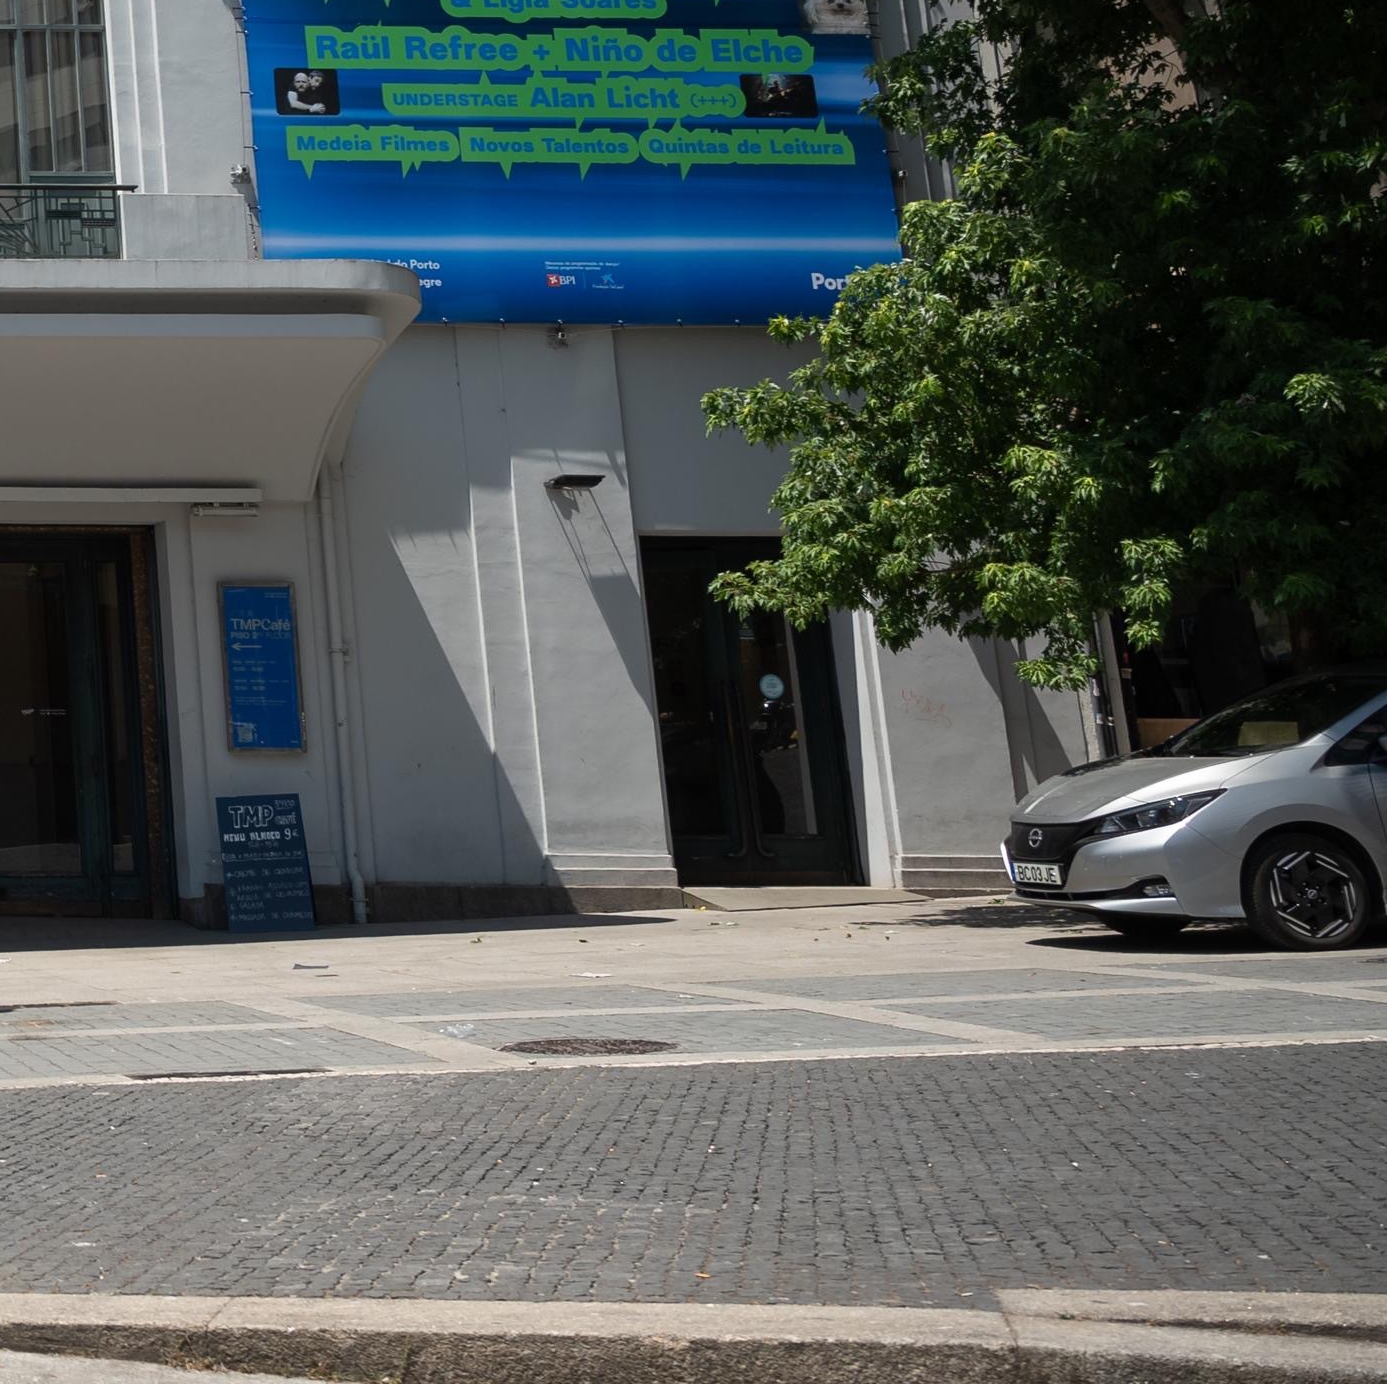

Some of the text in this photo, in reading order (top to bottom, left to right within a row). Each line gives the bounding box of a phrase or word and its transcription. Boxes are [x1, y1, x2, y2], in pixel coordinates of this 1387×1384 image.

[316, 35, 802, 63] Raül Refree + Niño de Elche
[393, 94, 516, 106] UNDERSTAGE
[531, 88, 594, 107] Alan
[607, 86, 679, 108] Licht
[297, 136, 449, 151] Medeia Filmes
[471, 137, 628, 152] Novos Talentos
[650, 139, 843, 154] Quintas de Leitura
[410, 259, 440, 270] Porto
[559, 275, 576, 285] BPI
[811, 272, 850, 290] Por
[228, 805, 274, 829] TMP
